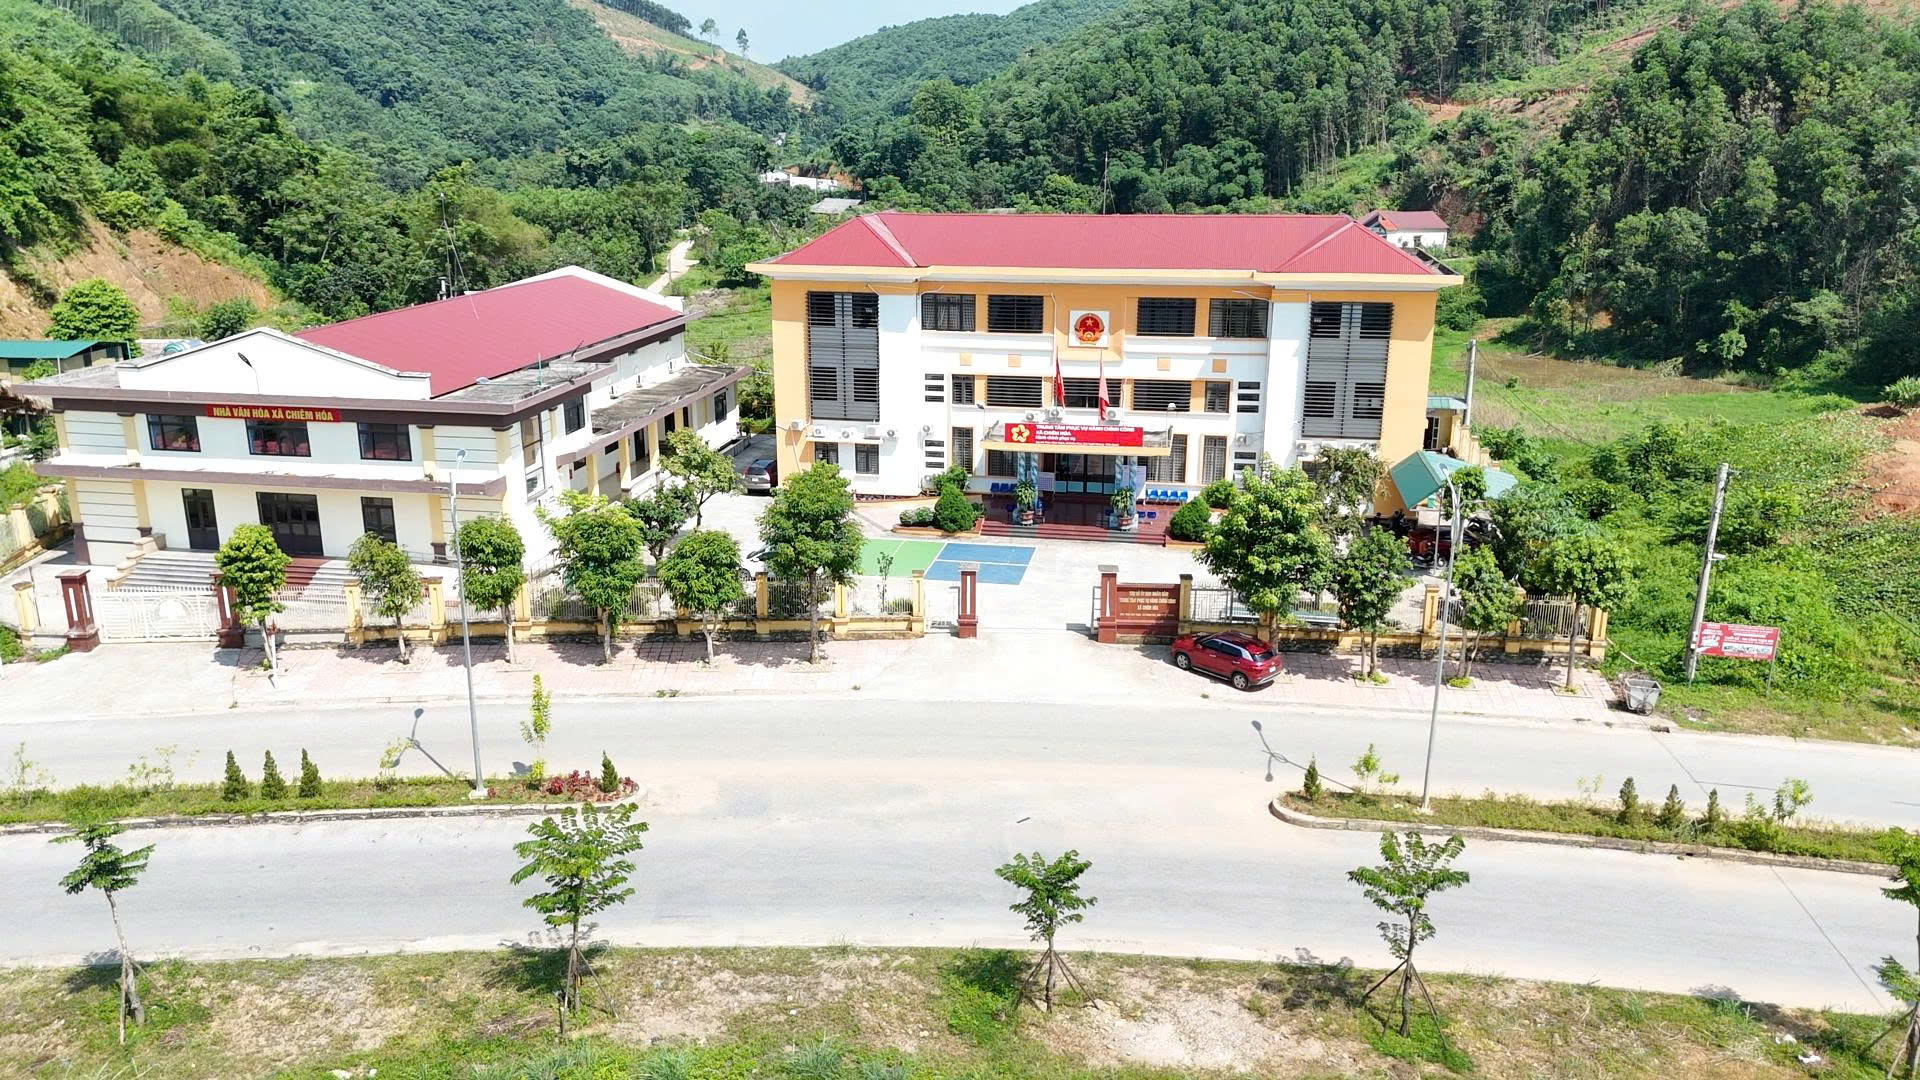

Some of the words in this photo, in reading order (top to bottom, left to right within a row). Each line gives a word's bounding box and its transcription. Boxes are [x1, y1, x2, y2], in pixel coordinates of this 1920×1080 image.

[213, 406, 231, 417] NHÀ
[232, 406, 251, 418] VĂN
[272, 408, 284, 419] XÃ
